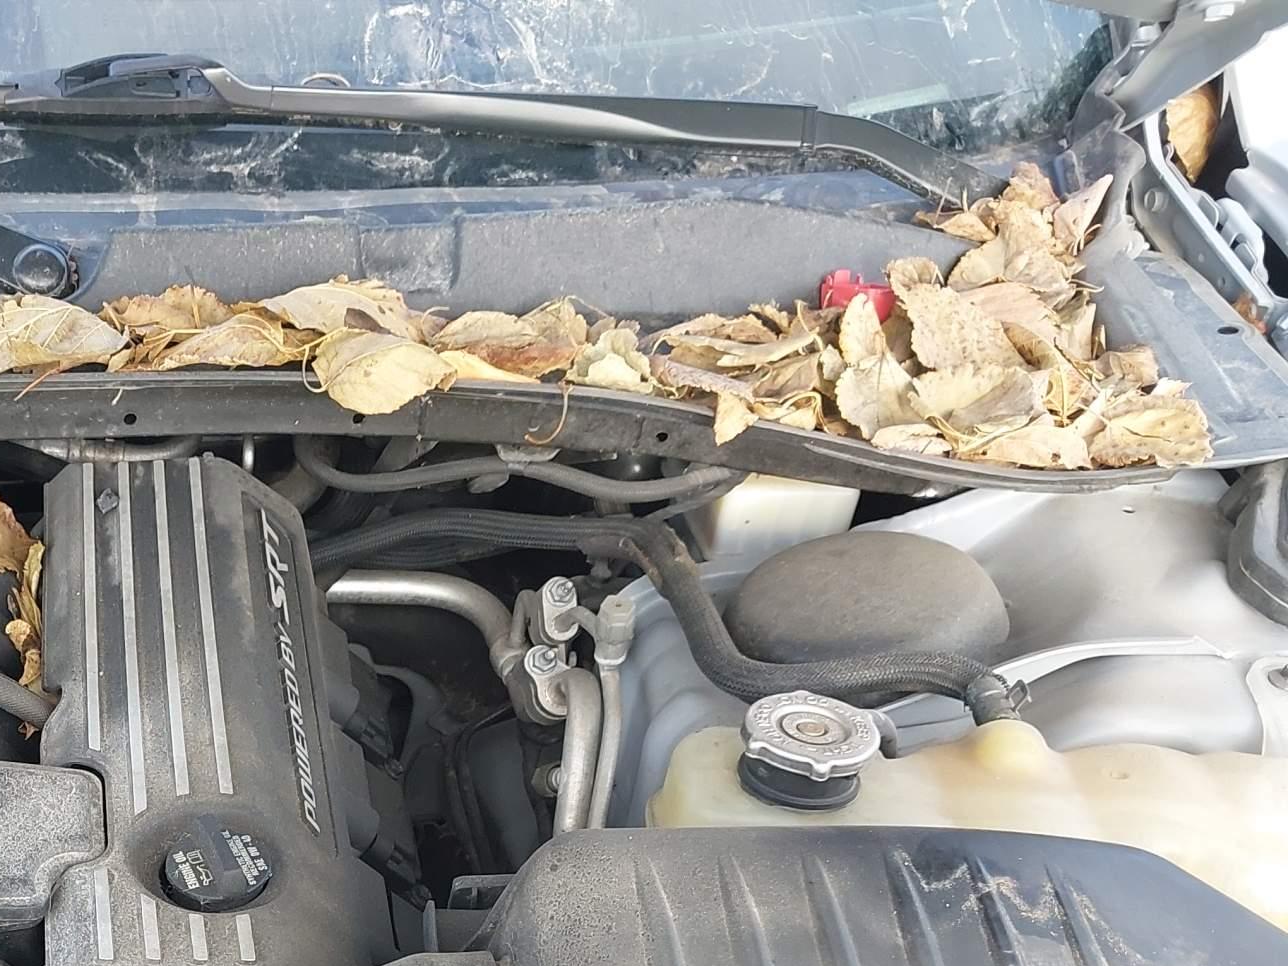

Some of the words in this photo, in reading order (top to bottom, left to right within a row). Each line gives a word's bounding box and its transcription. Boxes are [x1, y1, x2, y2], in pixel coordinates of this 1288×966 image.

[261, 507, 289, 626] SRT
[277, 621, 296, 671] BY
[284, 668, 321, 833] POWERED
[172, 850, 187, 864] OIL
[178, 861, 200, 890] ENGINE
[253, 857, 268, 871] SAE
